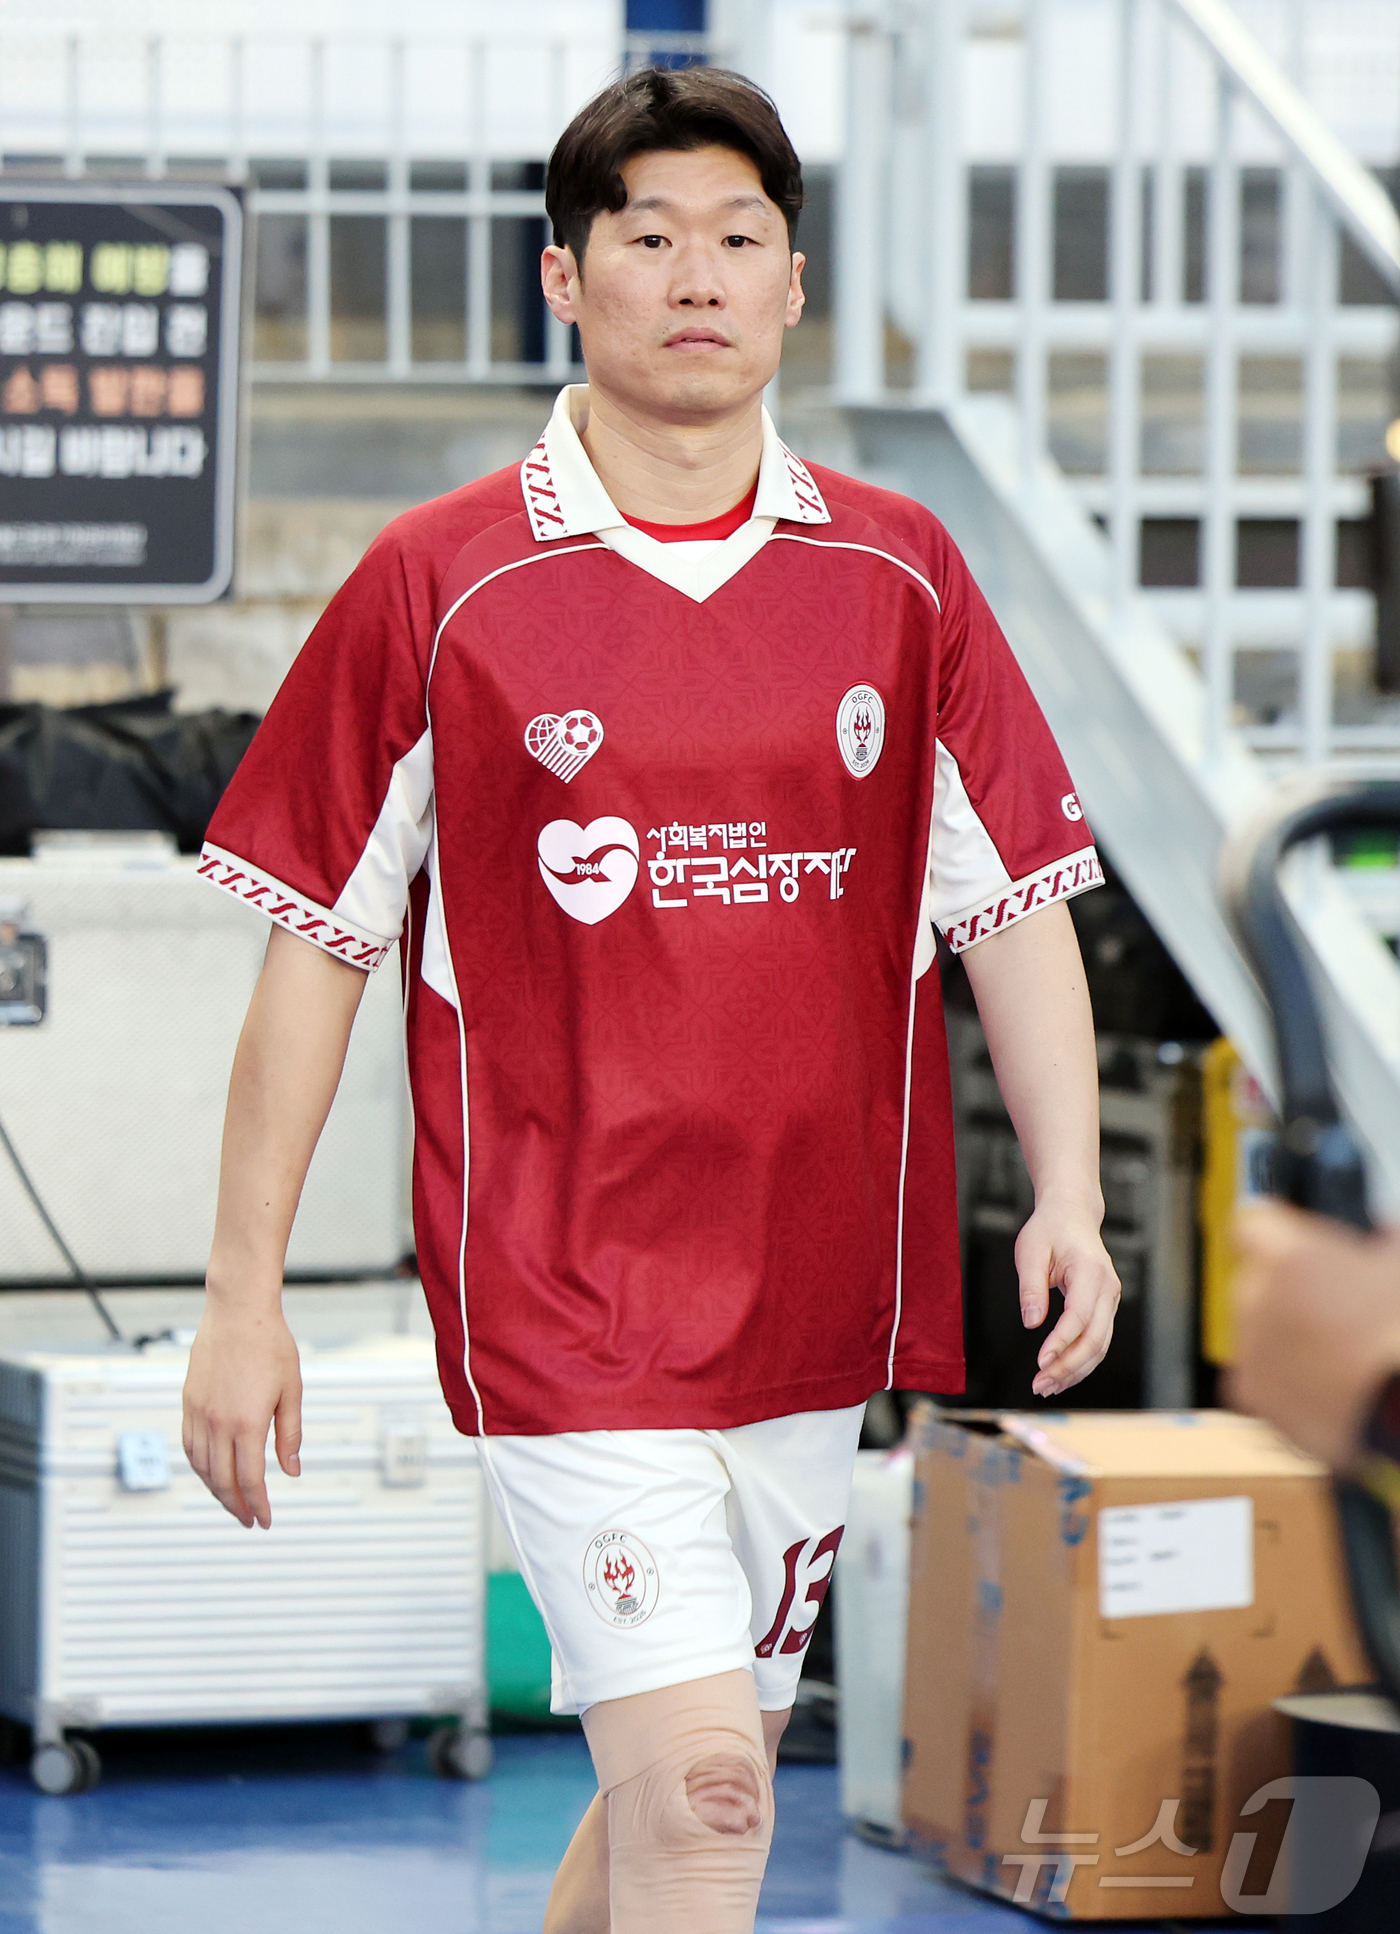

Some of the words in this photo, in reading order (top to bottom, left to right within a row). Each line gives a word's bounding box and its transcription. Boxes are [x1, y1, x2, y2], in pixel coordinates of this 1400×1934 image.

[0, 241, 83, 294] 충해
[852, 693, 873, 703] OGFC
[646, 821, 767, 851] 사회복지법인
[575, 863, 600, 875] 1984
[595, 1533, 627, 1548] OGFC
[754, 1524, 845, 1658] 13
